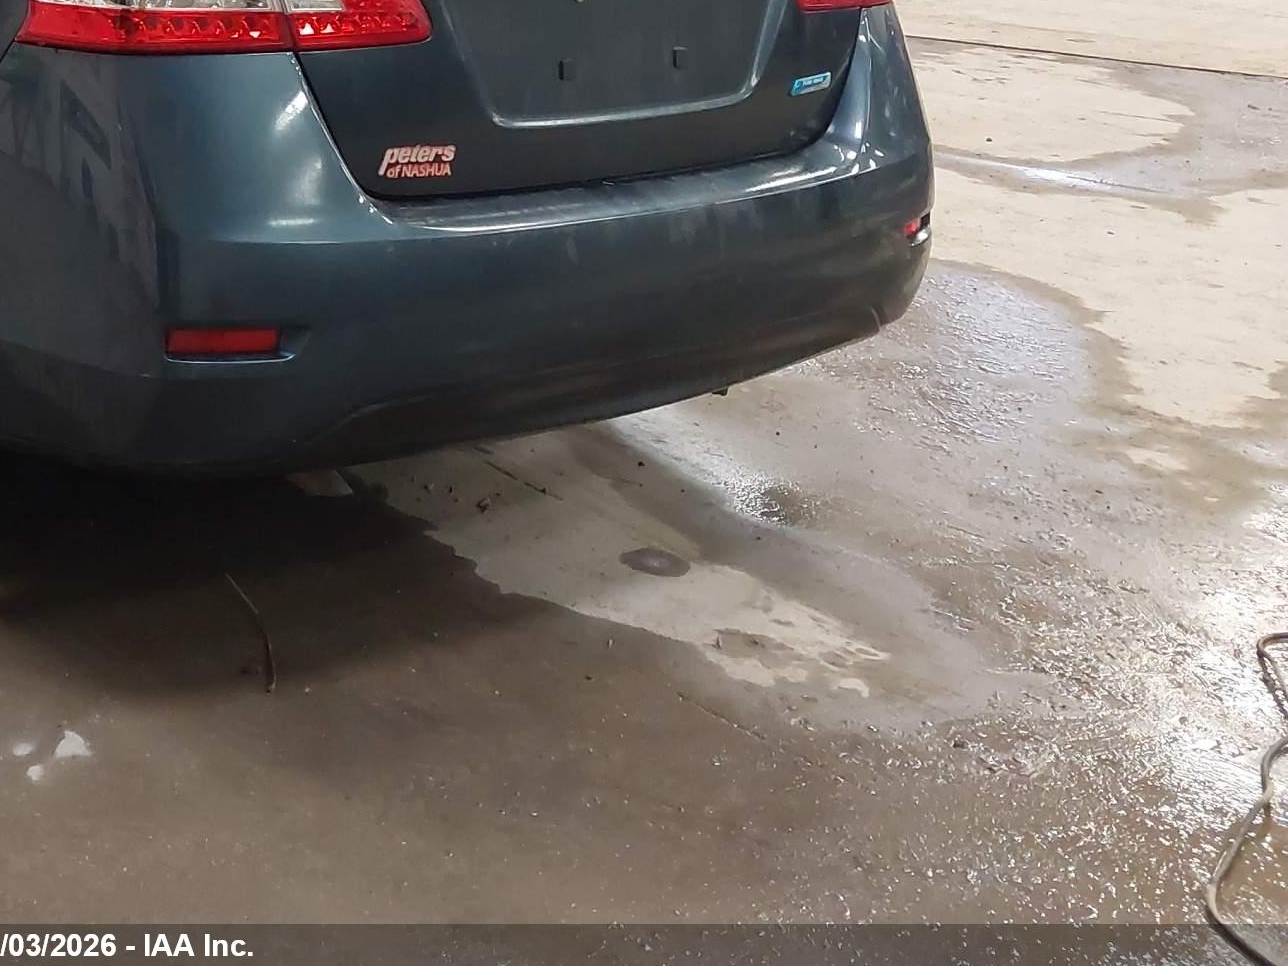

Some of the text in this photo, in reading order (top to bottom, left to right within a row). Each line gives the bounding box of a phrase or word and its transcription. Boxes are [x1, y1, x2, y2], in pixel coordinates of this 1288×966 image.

[378, 144, 456, 176] peters
[387, 162, 452, 178] of NASHUA
